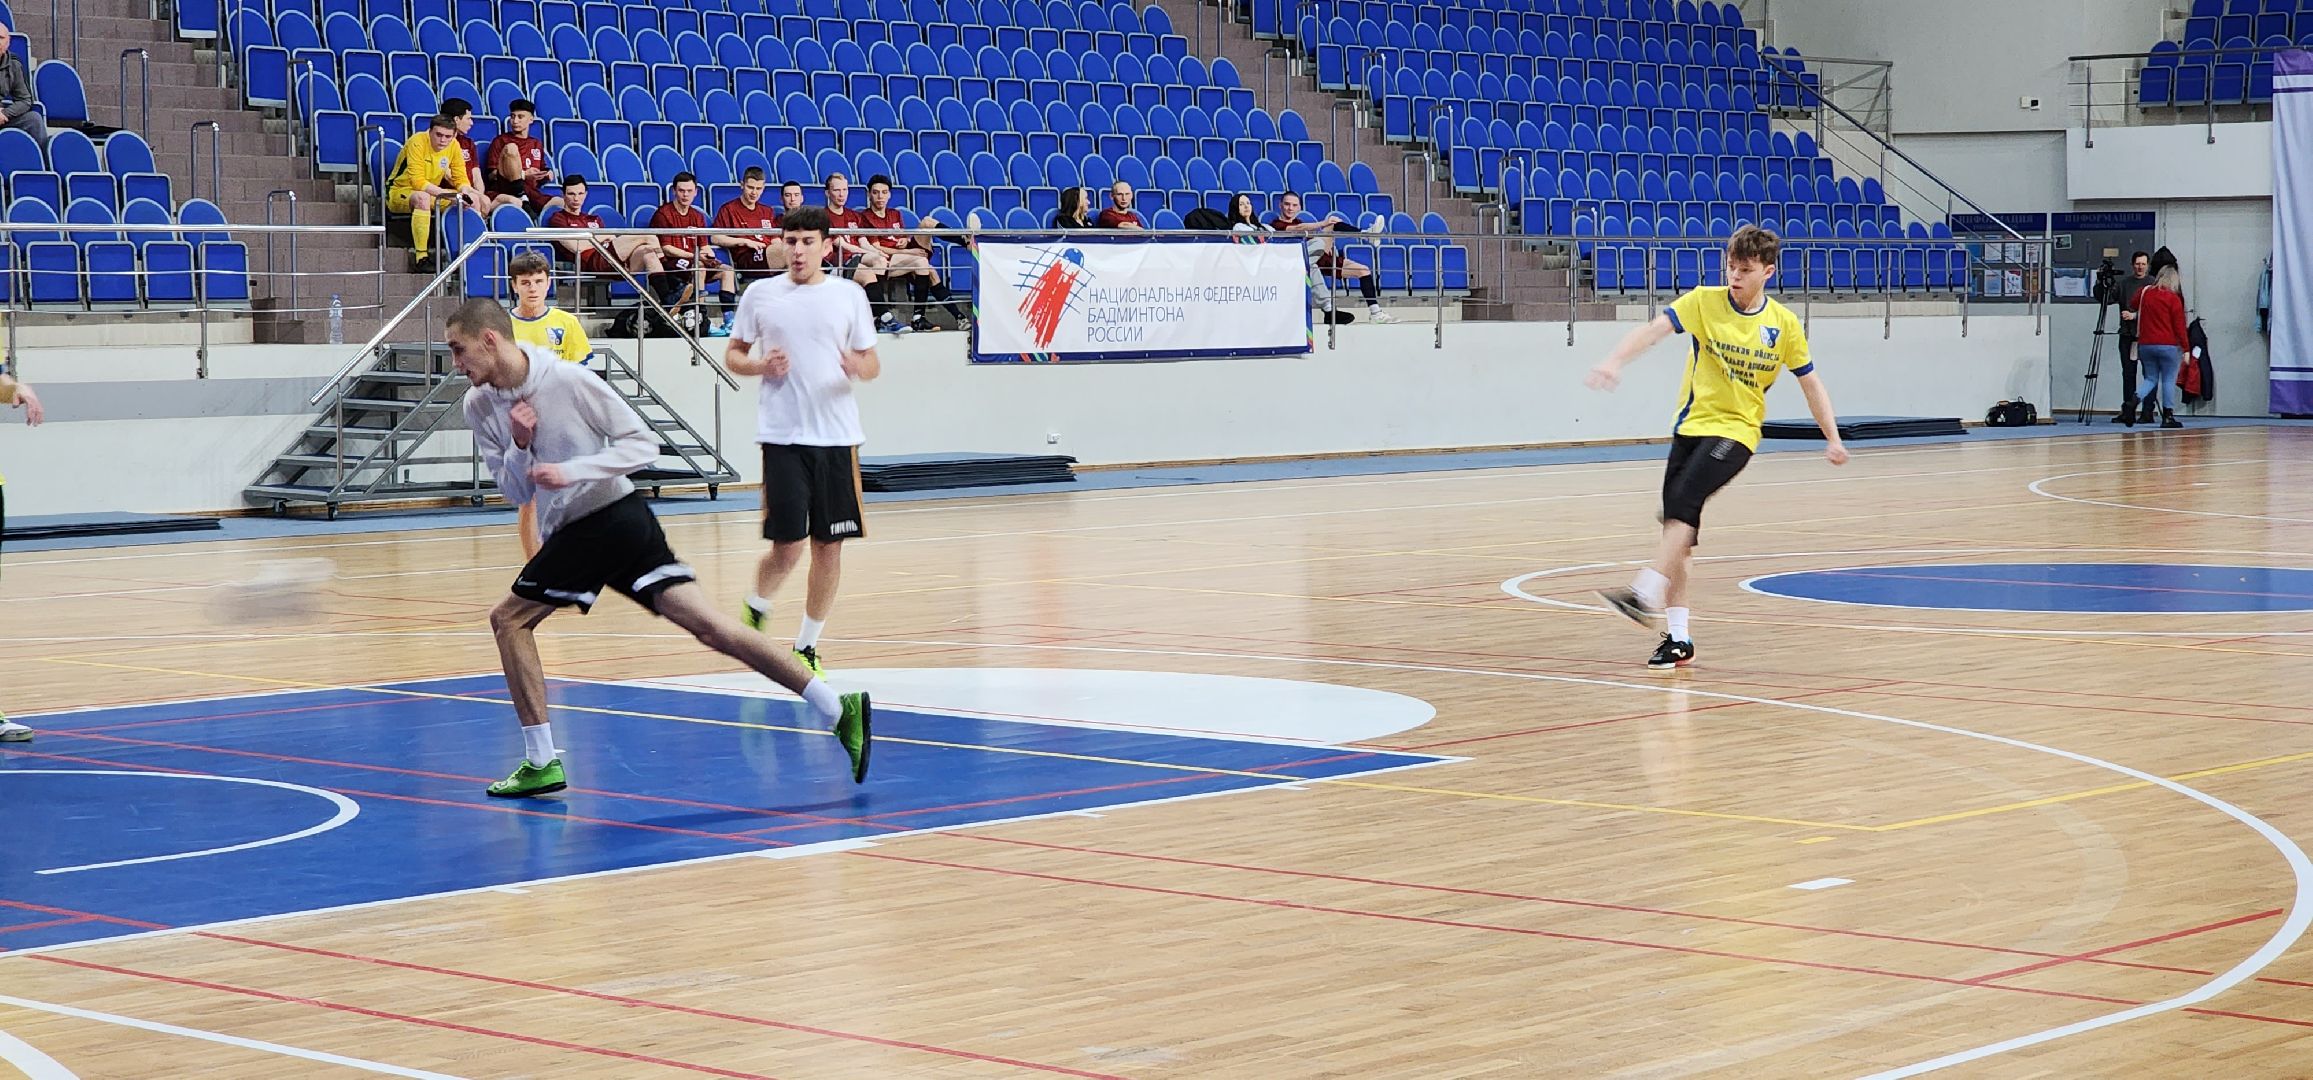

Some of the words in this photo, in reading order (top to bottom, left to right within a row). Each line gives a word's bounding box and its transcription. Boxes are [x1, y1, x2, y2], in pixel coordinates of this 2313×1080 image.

[2064, 213, 2142, 223] ИНФОРМАЦИЯ
[1089, 286, 1200, 305] НАЦИОНАЛЬНАЯ
[1203, 286, 1277, 304] ФЕДЕРАЦИЯ
[1087, 306, 1185, 325] БАДМИНТОНА
[1087, 326, 1143, 343] РОССИИ
